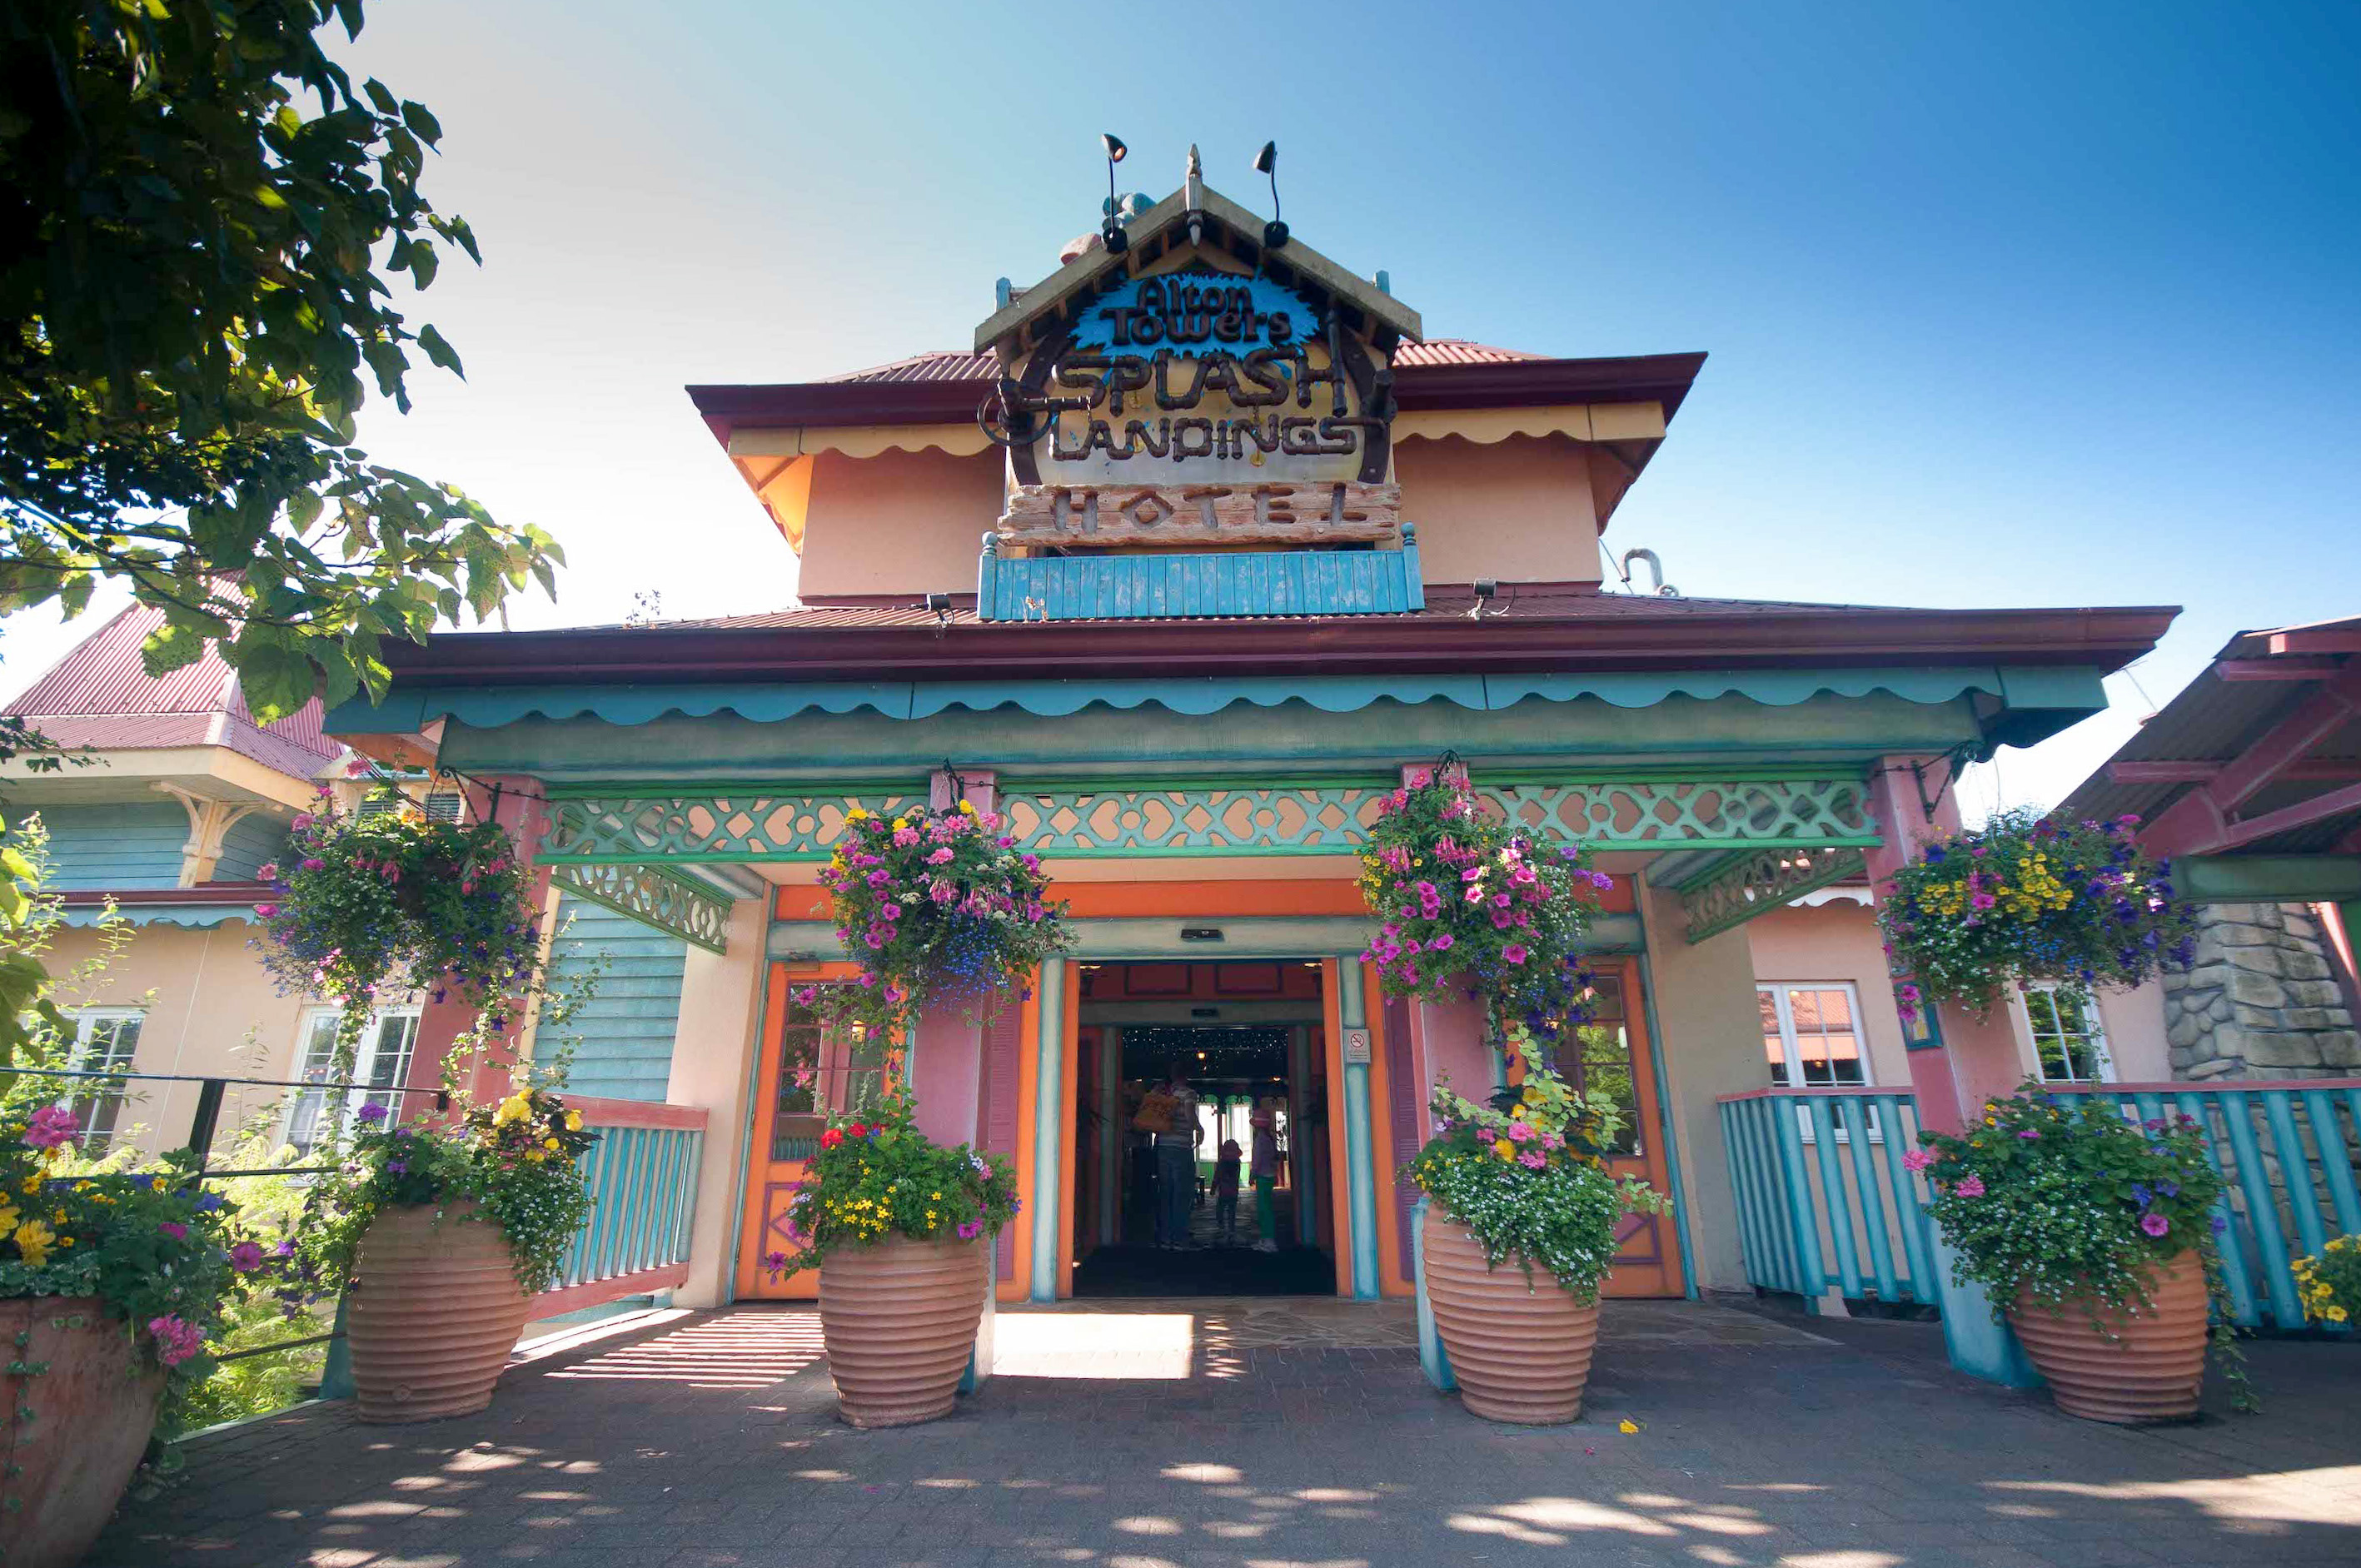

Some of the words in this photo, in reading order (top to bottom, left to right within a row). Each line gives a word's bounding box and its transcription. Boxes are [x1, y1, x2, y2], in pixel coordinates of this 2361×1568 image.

[1137, 276, 1253, 320] Alton
[1099, 306, 1293, 345] Towers
[1051, 347, 1348, 416] SPLASH
[1048, 411, 1359, 462] LANDINGS
[1053, 482, 1369, 535] HOTEL
